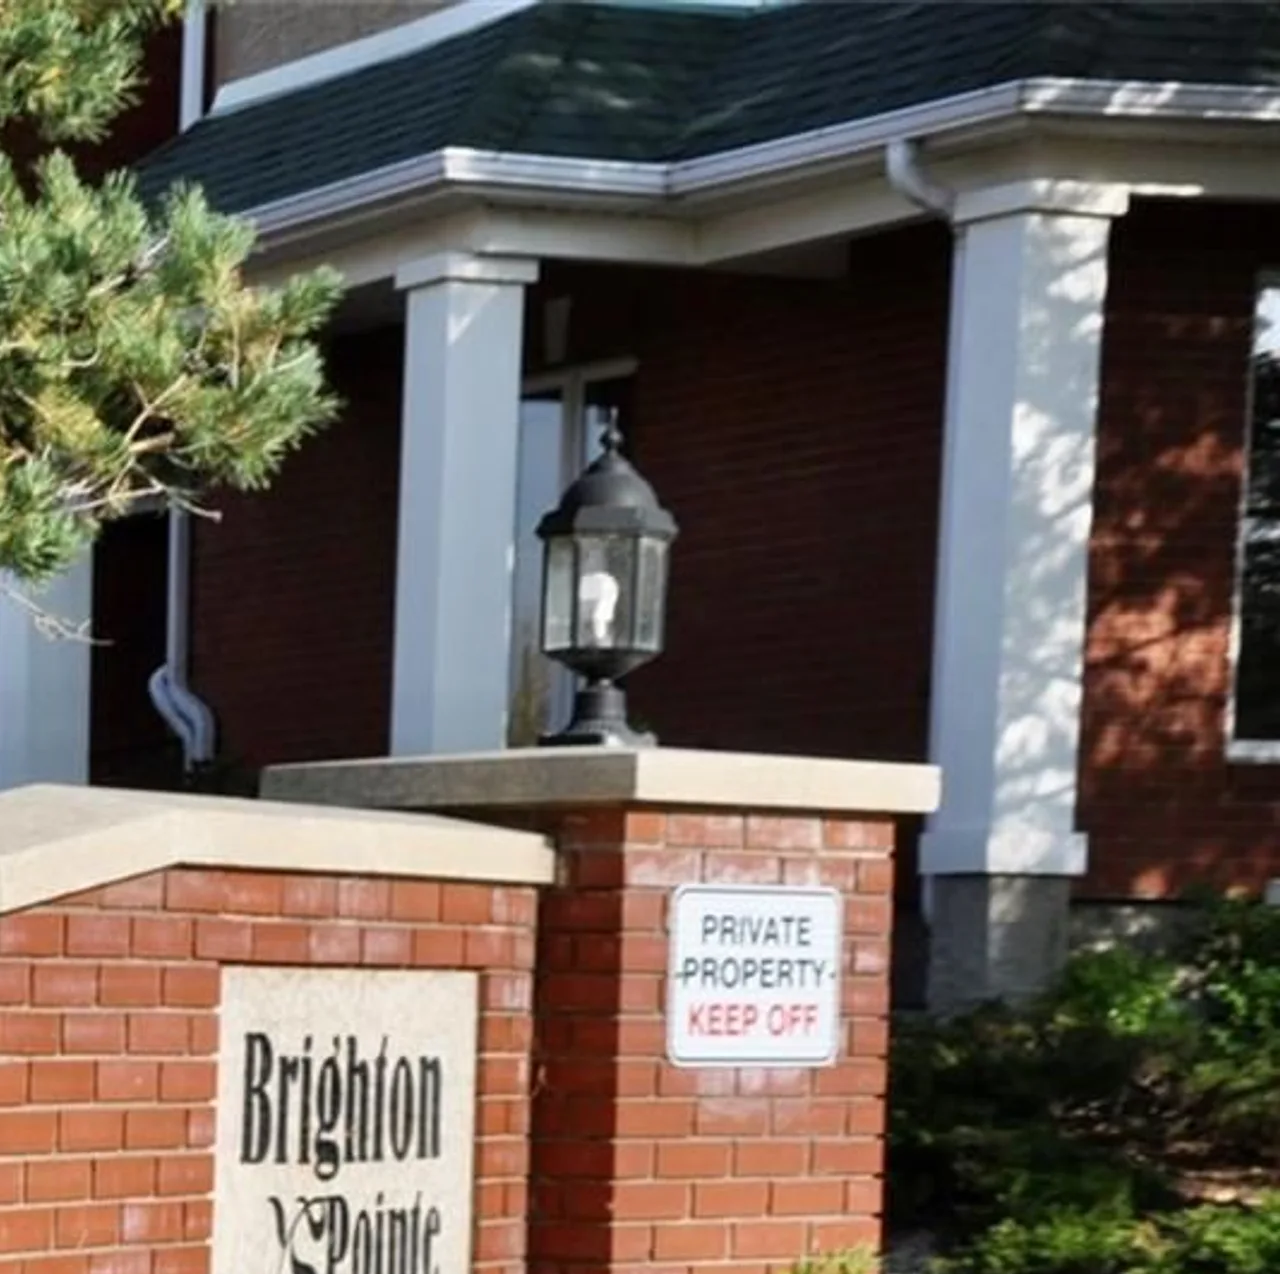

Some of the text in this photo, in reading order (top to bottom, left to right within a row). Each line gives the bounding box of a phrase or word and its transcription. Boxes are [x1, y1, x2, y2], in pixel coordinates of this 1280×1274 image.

[701, 914, 812, 946] PRIVATE
[682, 956, 827, 989] PROPERTY
[687, 1003, 819, 1037] KEEP OFF
[240, 1031, 442, 1182] Brighton
